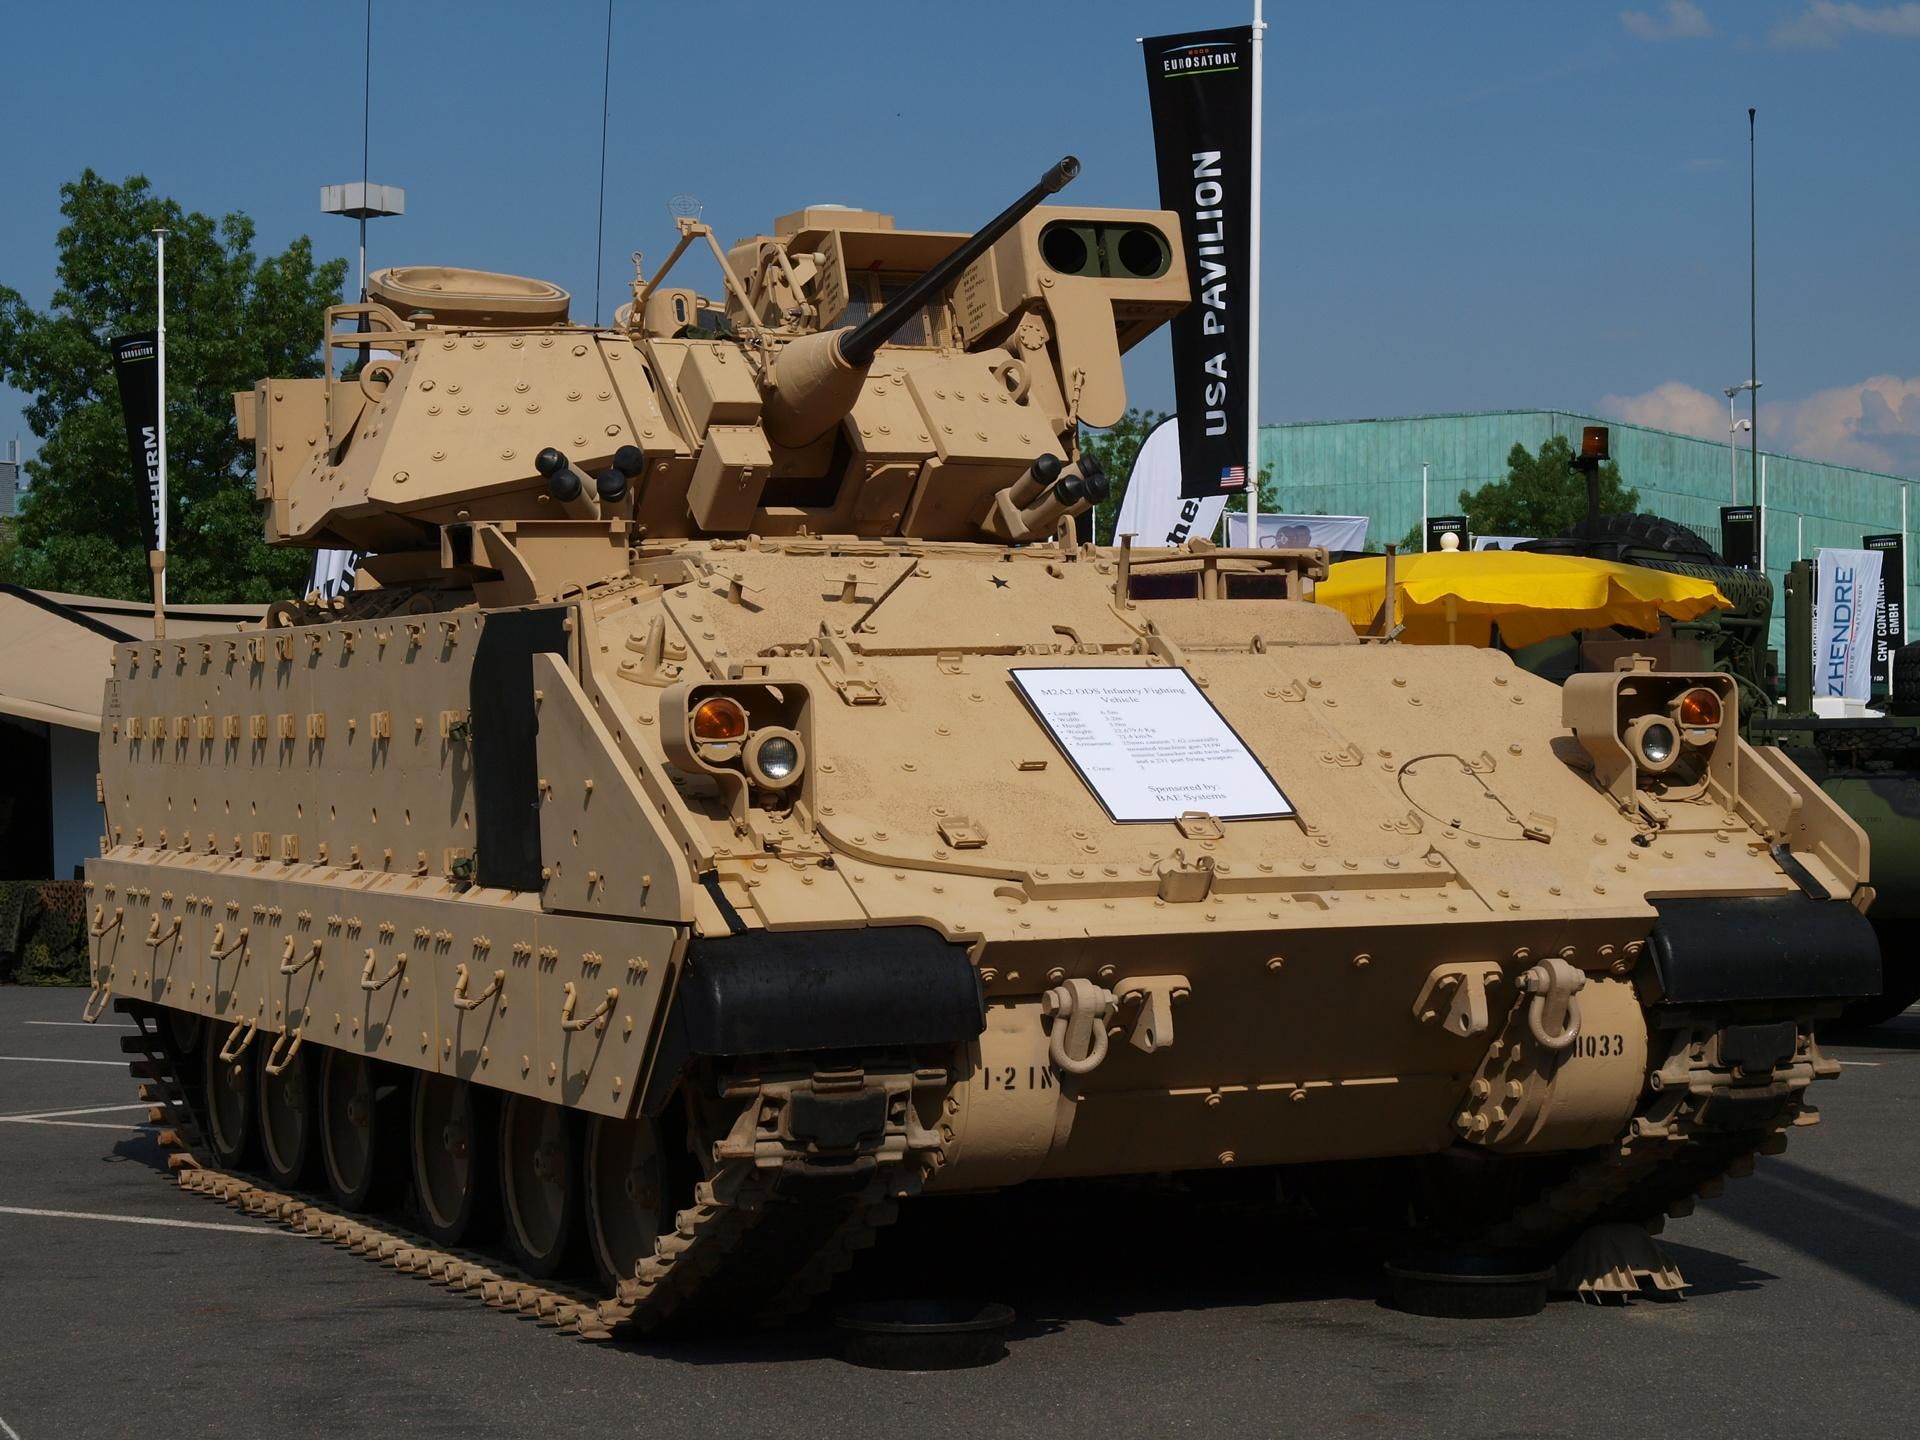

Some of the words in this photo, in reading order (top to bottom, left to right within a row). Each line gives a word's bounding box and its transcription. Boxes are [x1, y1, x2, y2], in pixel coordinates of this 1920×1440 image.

[1163, 52, 1237, 72] EUROSATORY
[1192, 150, 1227, 336] PAVILION
[1204, 352, 1227, 437] USA
[1888, 603, 1900, 635] GMBH
[1877, 640, 1888, 662] CHV
[1040, 688, 1073, 696] M2A2
[1102, 687, 1142, 696] Infantry
[1143, 687, 1187, 695] Fighting
[1147, 784, 1202, 793] Sponsored
[1155, 794, 1183, 802] BAE
[1184, 793, 1228, 802] Systems
